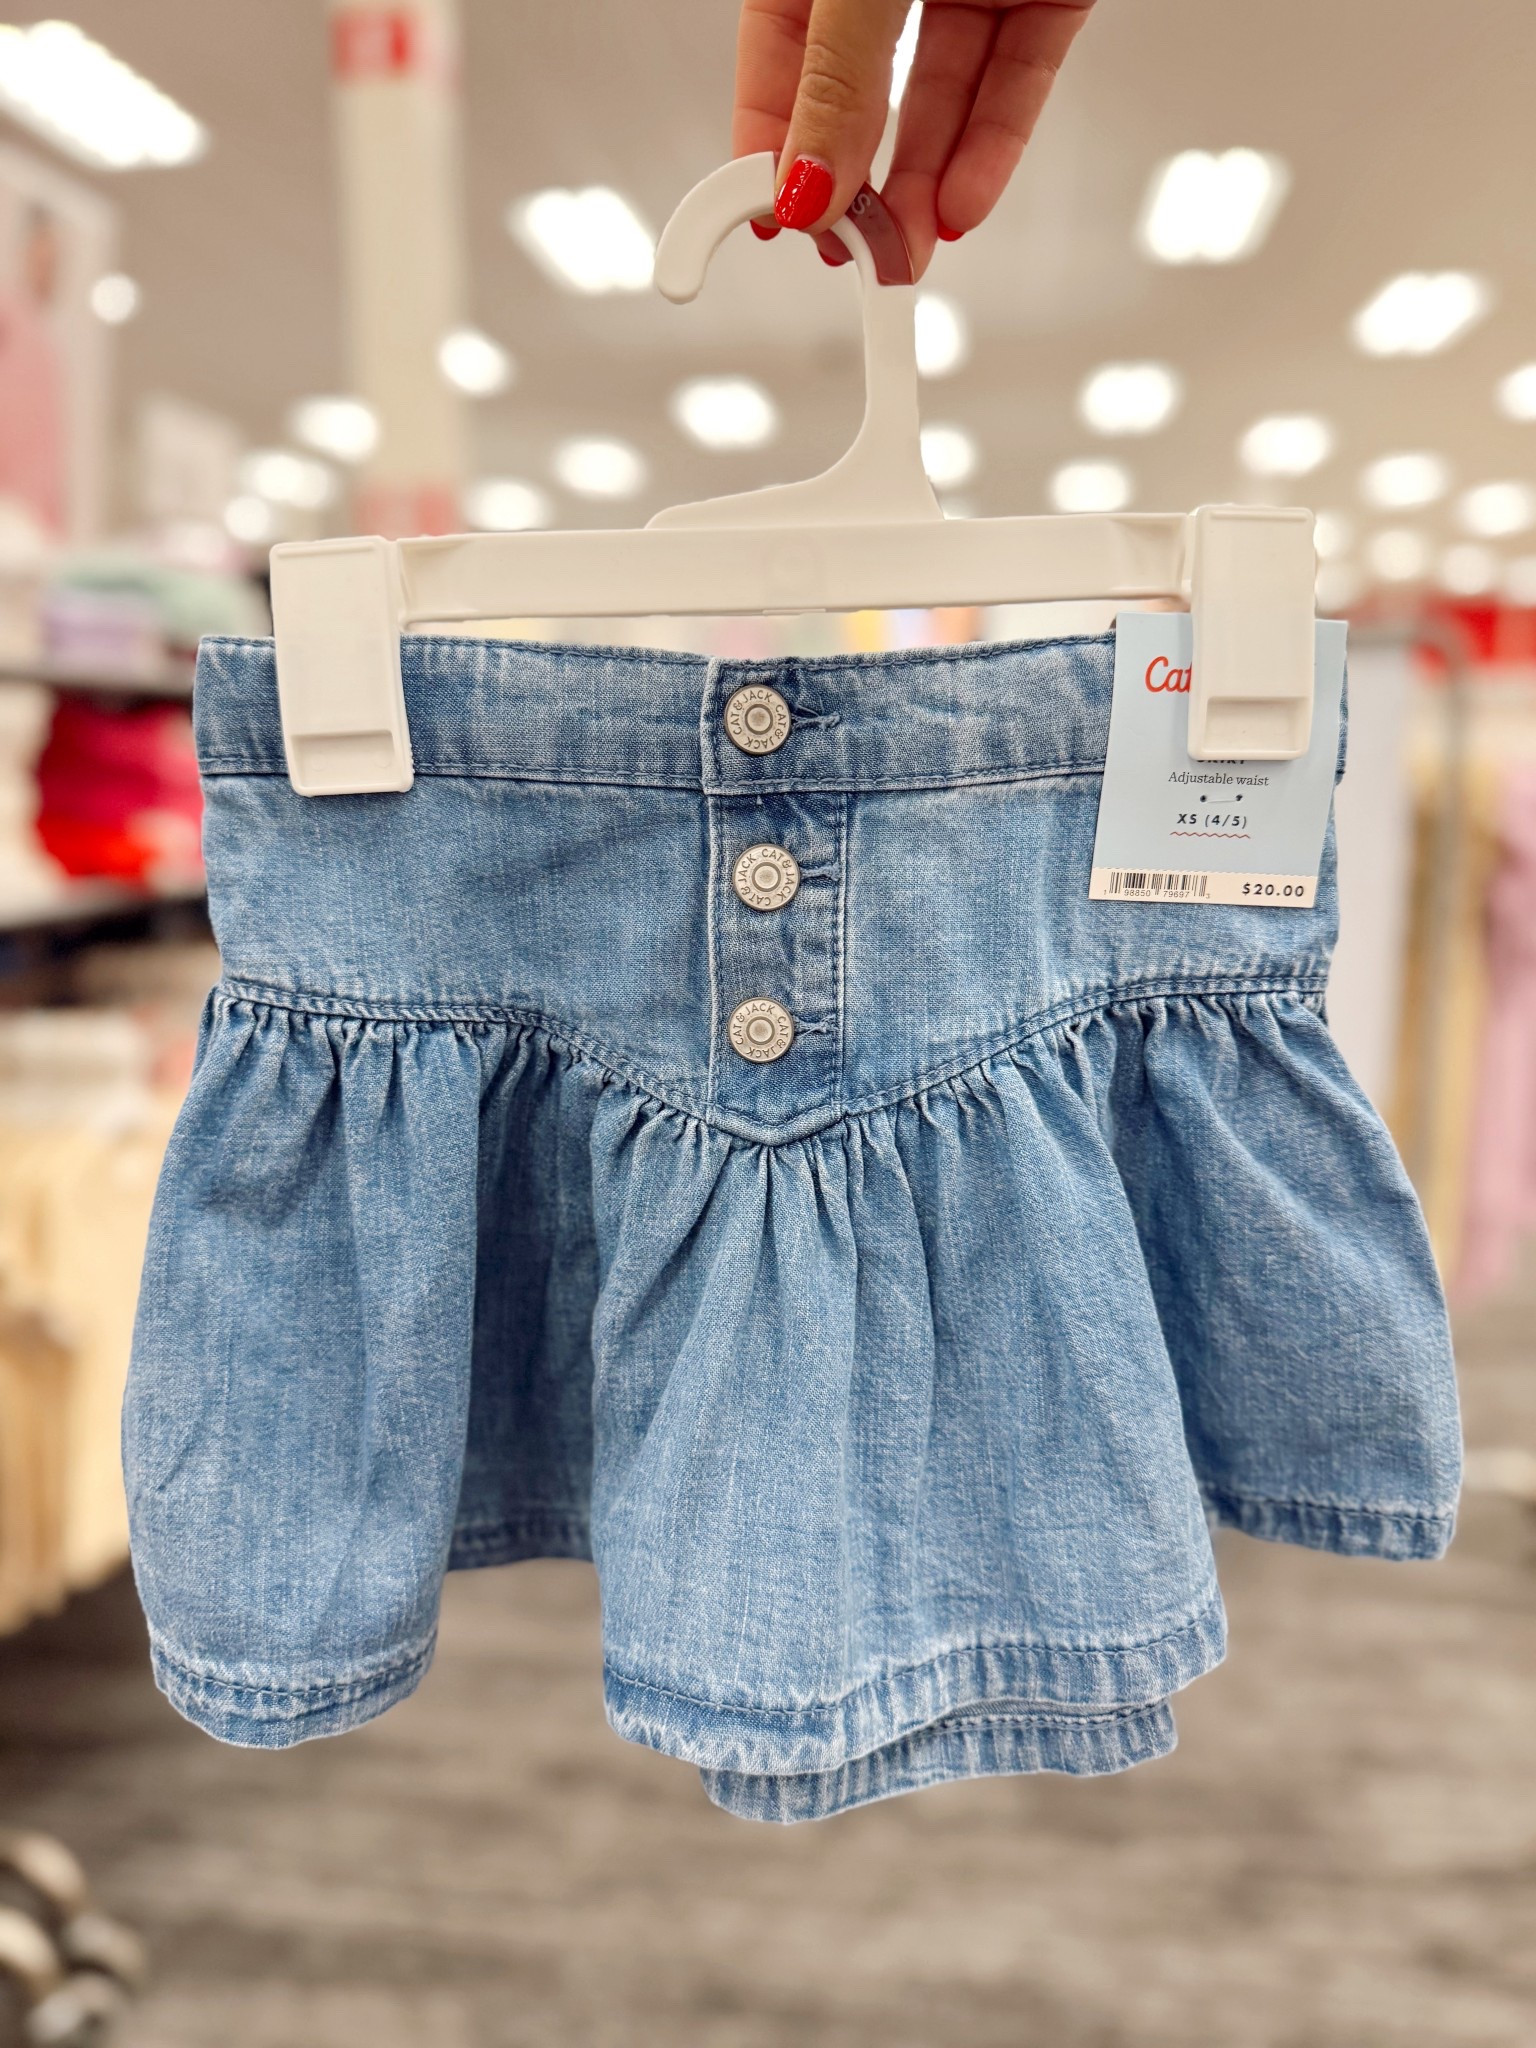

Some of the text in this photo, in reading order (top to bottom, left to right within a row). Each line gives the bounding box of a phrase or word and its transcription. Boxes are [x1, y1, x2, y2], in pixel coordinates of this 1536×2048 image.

[731, 712, 742, 735] CAT
[743, 690, 773, 703] JACK
[775, 705, 786, 728] CAT
[744, 736, 774, 749] JACK
[1168, 772, 1270, 786] Adjustable waist
[1177, 813, 1247, 829] XS (4/5)
[738, 854, 756, 882] JACK
[762, 848, 784, 861] CAT
[776, 872, 795, 901] JACK
[1124, 889, 1151, 897] 98850
[1163, 890, 1190, 898] 79697
[1242, 882, 1304, 898] $20.00
[749, 893, 771, 906] CAT
[733, 1024, 743, 1045] CAT
[746, 1003, 776, 1015] JACK
[777, 1016, 789, 1037] CAT
[746, 1046, 776, 1058] JACK
